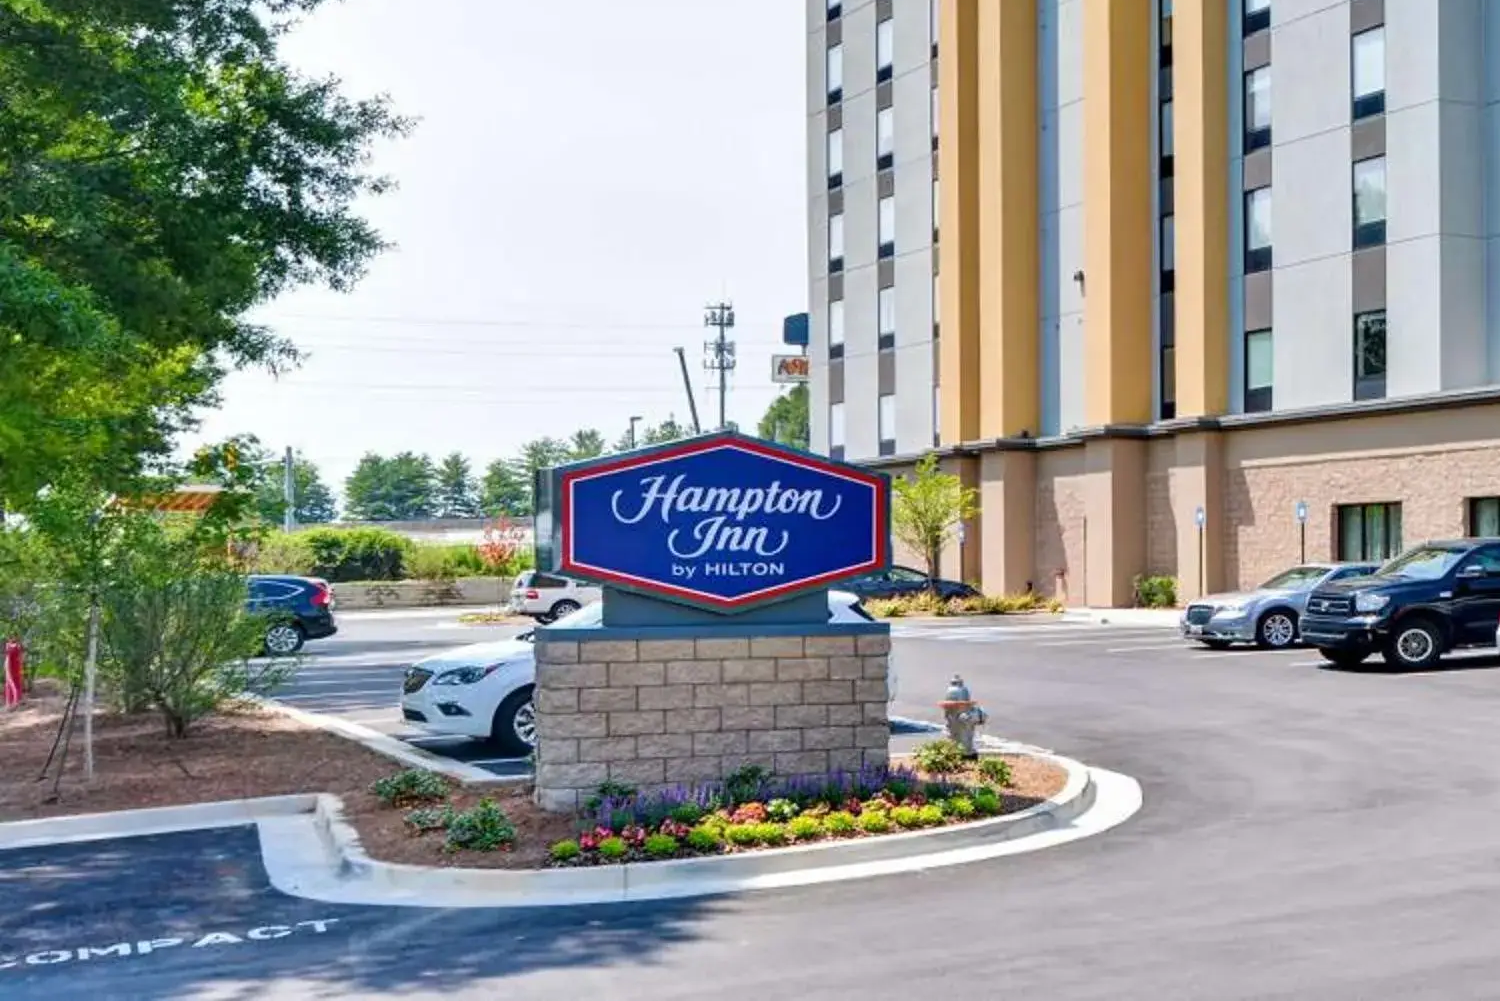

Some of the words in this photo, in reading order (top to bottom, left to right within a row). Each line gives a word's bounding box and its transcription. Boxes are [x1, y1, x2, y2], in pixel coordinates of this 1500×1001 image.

[611, 474, 842, 524] Hampton
[667, 515, 789, 558] Inn
[672, 562, 697, 579] by
[704, 562, 785, 576] HILTON
